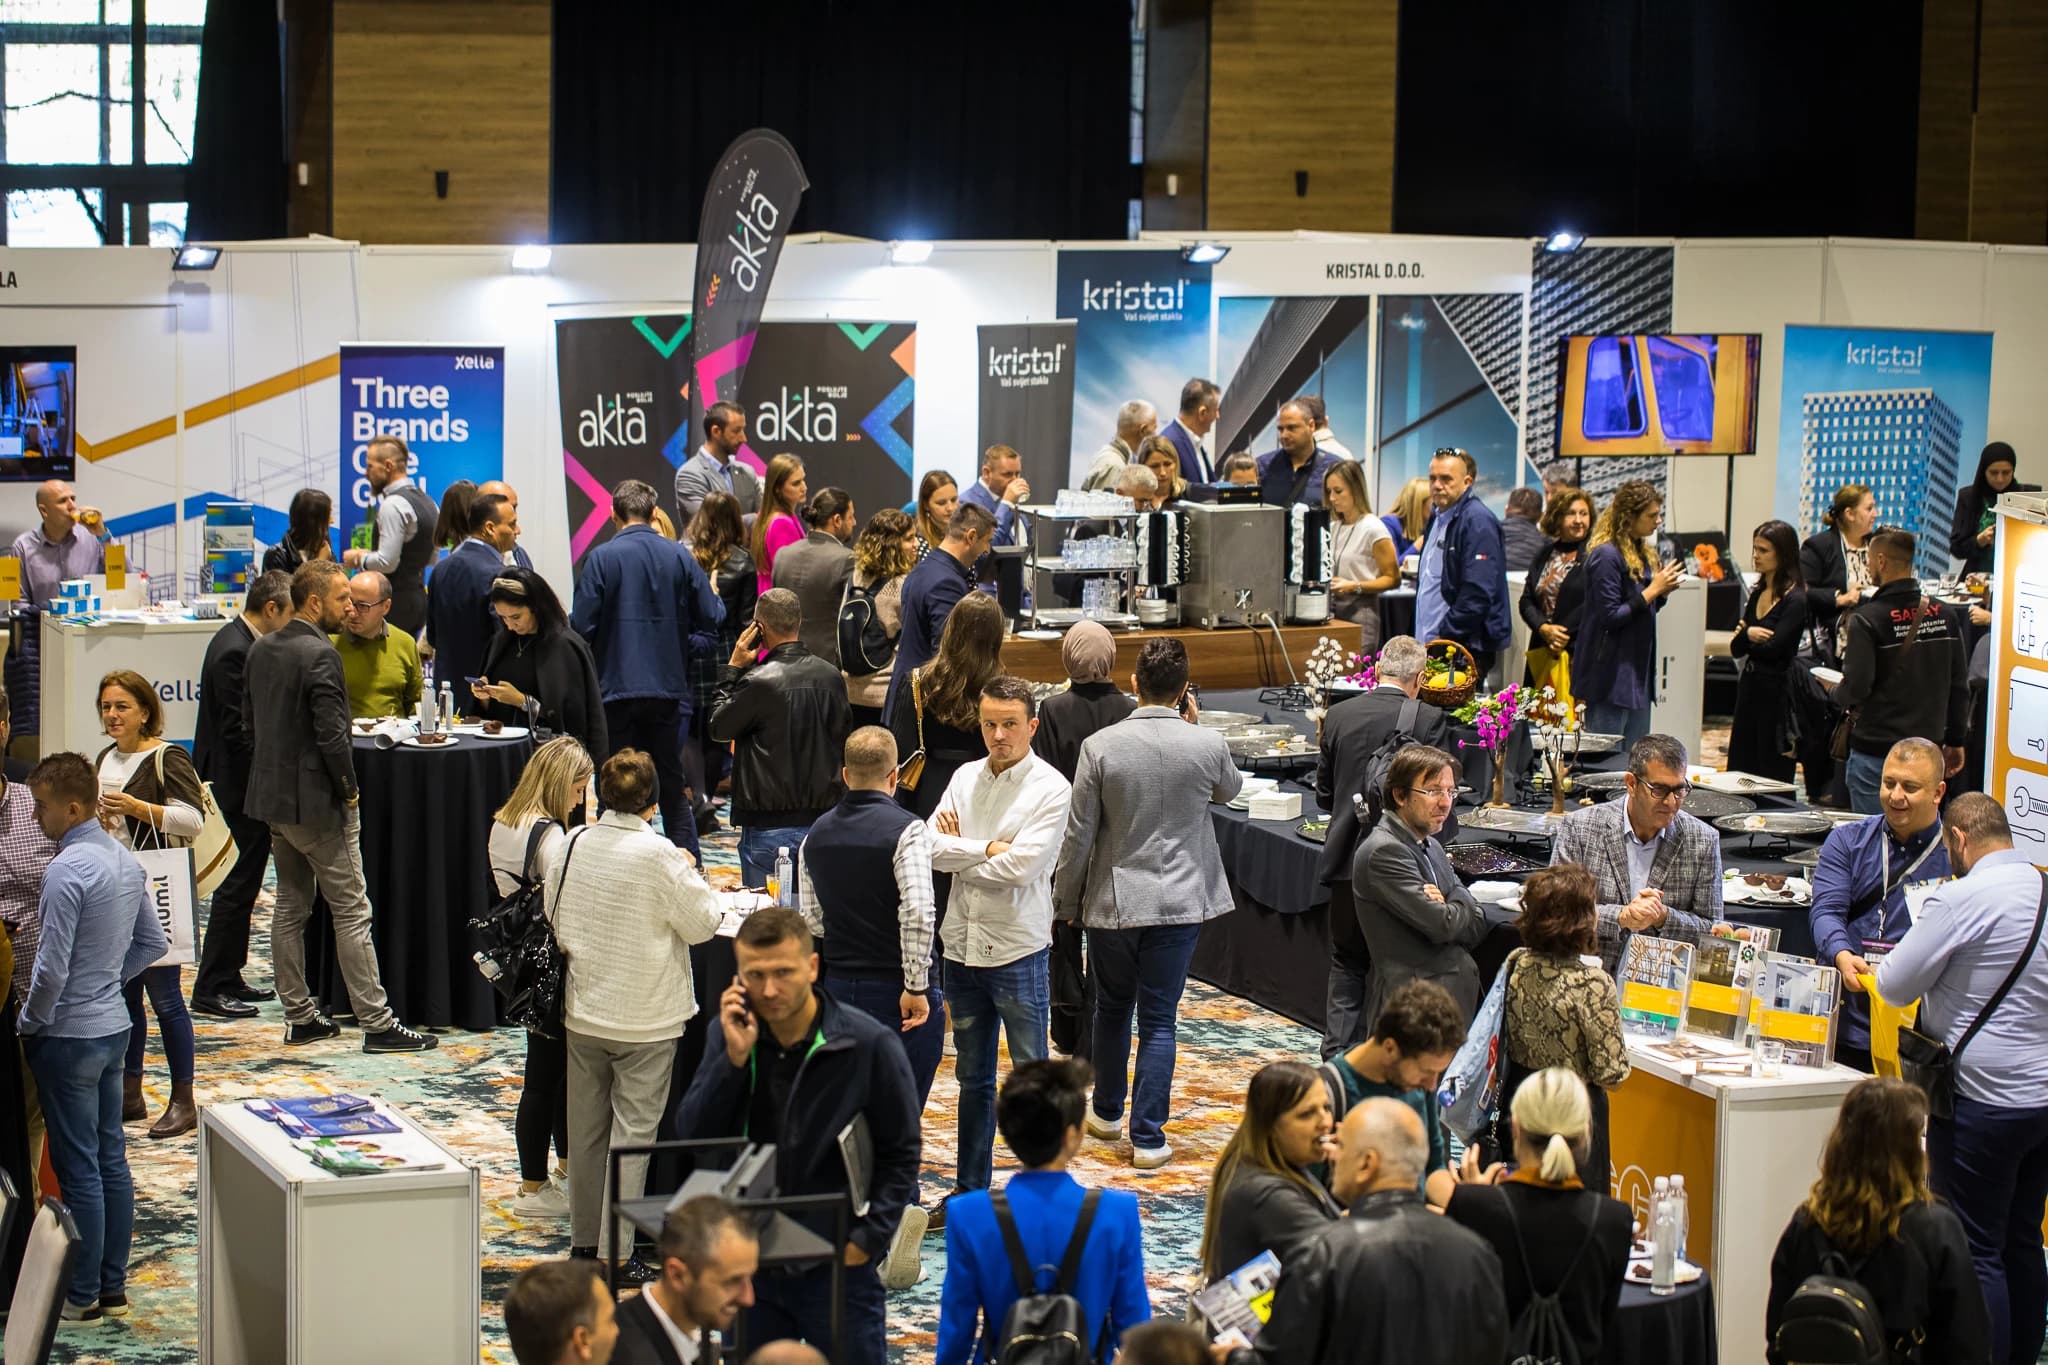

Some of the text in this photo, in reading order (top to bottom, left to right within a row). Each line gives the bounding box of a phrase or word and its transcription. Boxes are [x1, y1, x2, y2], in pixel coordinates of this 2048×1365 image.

[728, 193, 779, 293] akta
[1326, 262, 1424, 279] KRISTAL D.O.O.
[1083, 279, 1183, 310] kristal
[455, 355, 494, 370] Xella
[989, 343, 1061, 376] kristal
[1846, 342, 1923, 367] kristal
[352, 376, 450, 409] Three
[353, 411, 469, 442] Brands
[578, 393, 646, 447] akta
[756, 386, 837, 442] akta
[352, 444, 419, 475] Oe
[153, 680, 201, 702] ella
